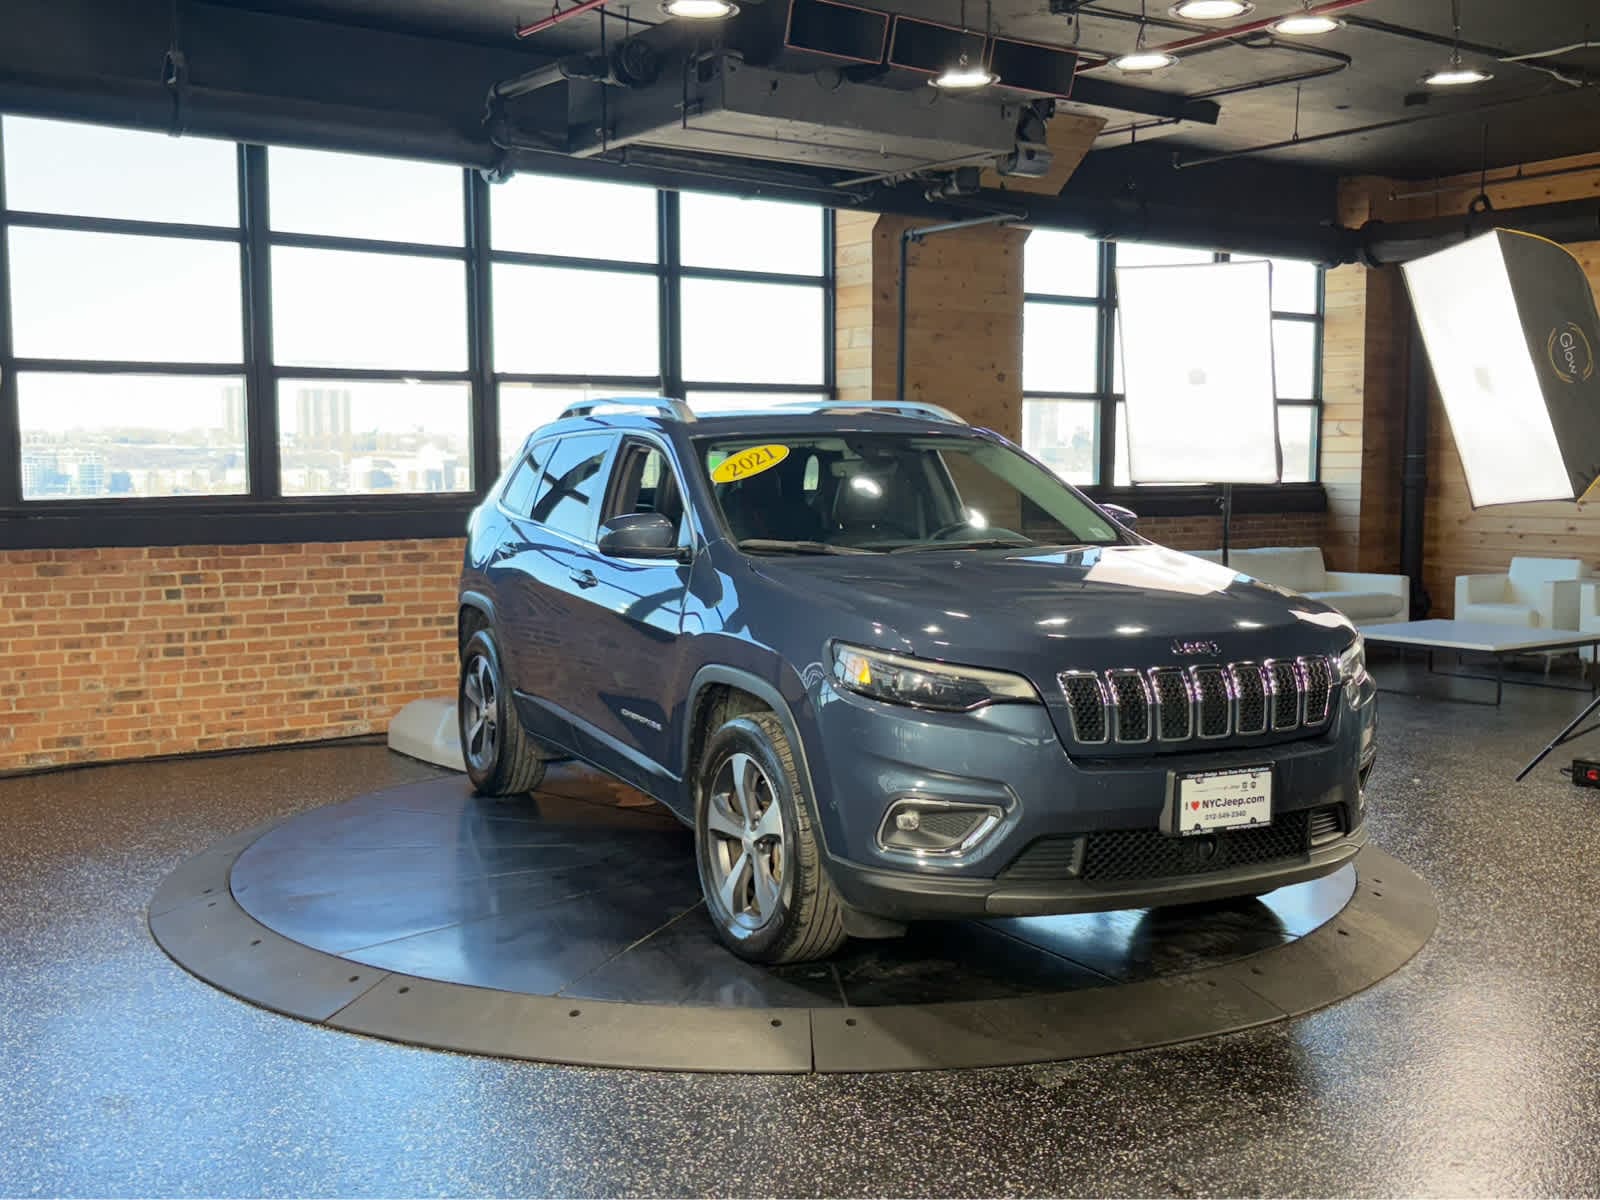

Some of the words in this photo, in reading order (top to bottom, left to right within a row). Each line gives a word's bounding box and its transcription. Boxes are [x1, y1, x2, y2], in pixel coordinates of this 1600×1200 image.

[1560, 332, 1577, 374] Glow
[725, 448, 776, 477] 2021
[1202, 795, 1265, 808] NYCJeep.com
